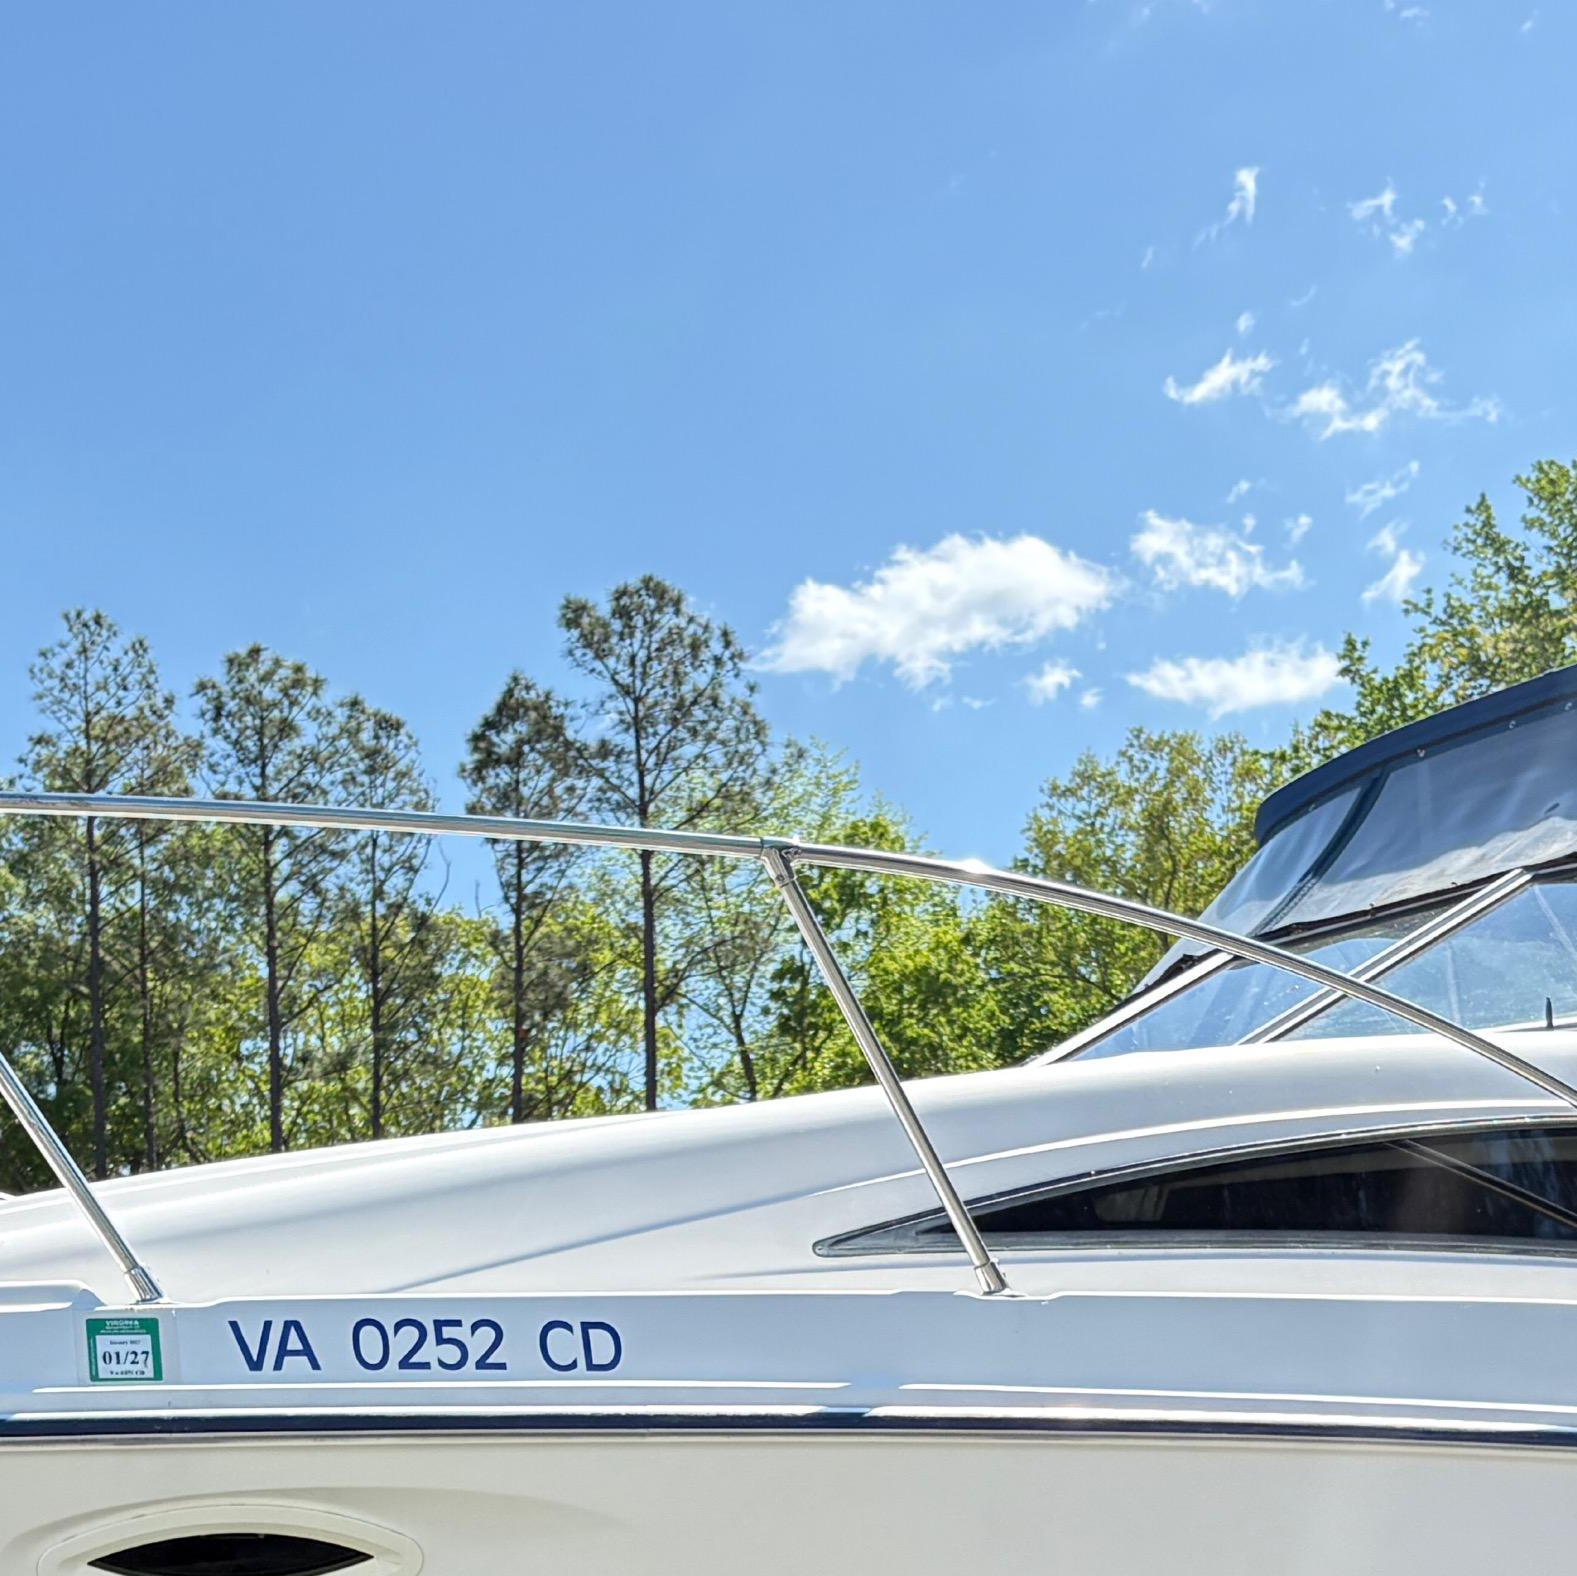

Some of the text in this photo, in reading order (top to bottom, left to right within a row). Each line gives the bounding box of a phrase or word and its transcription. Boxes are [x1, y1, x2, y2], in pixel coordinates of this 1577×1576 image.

[102, 1350, 150, 1368] 01/27
[228, 1318, 622, 1372] VA 0252 CD
